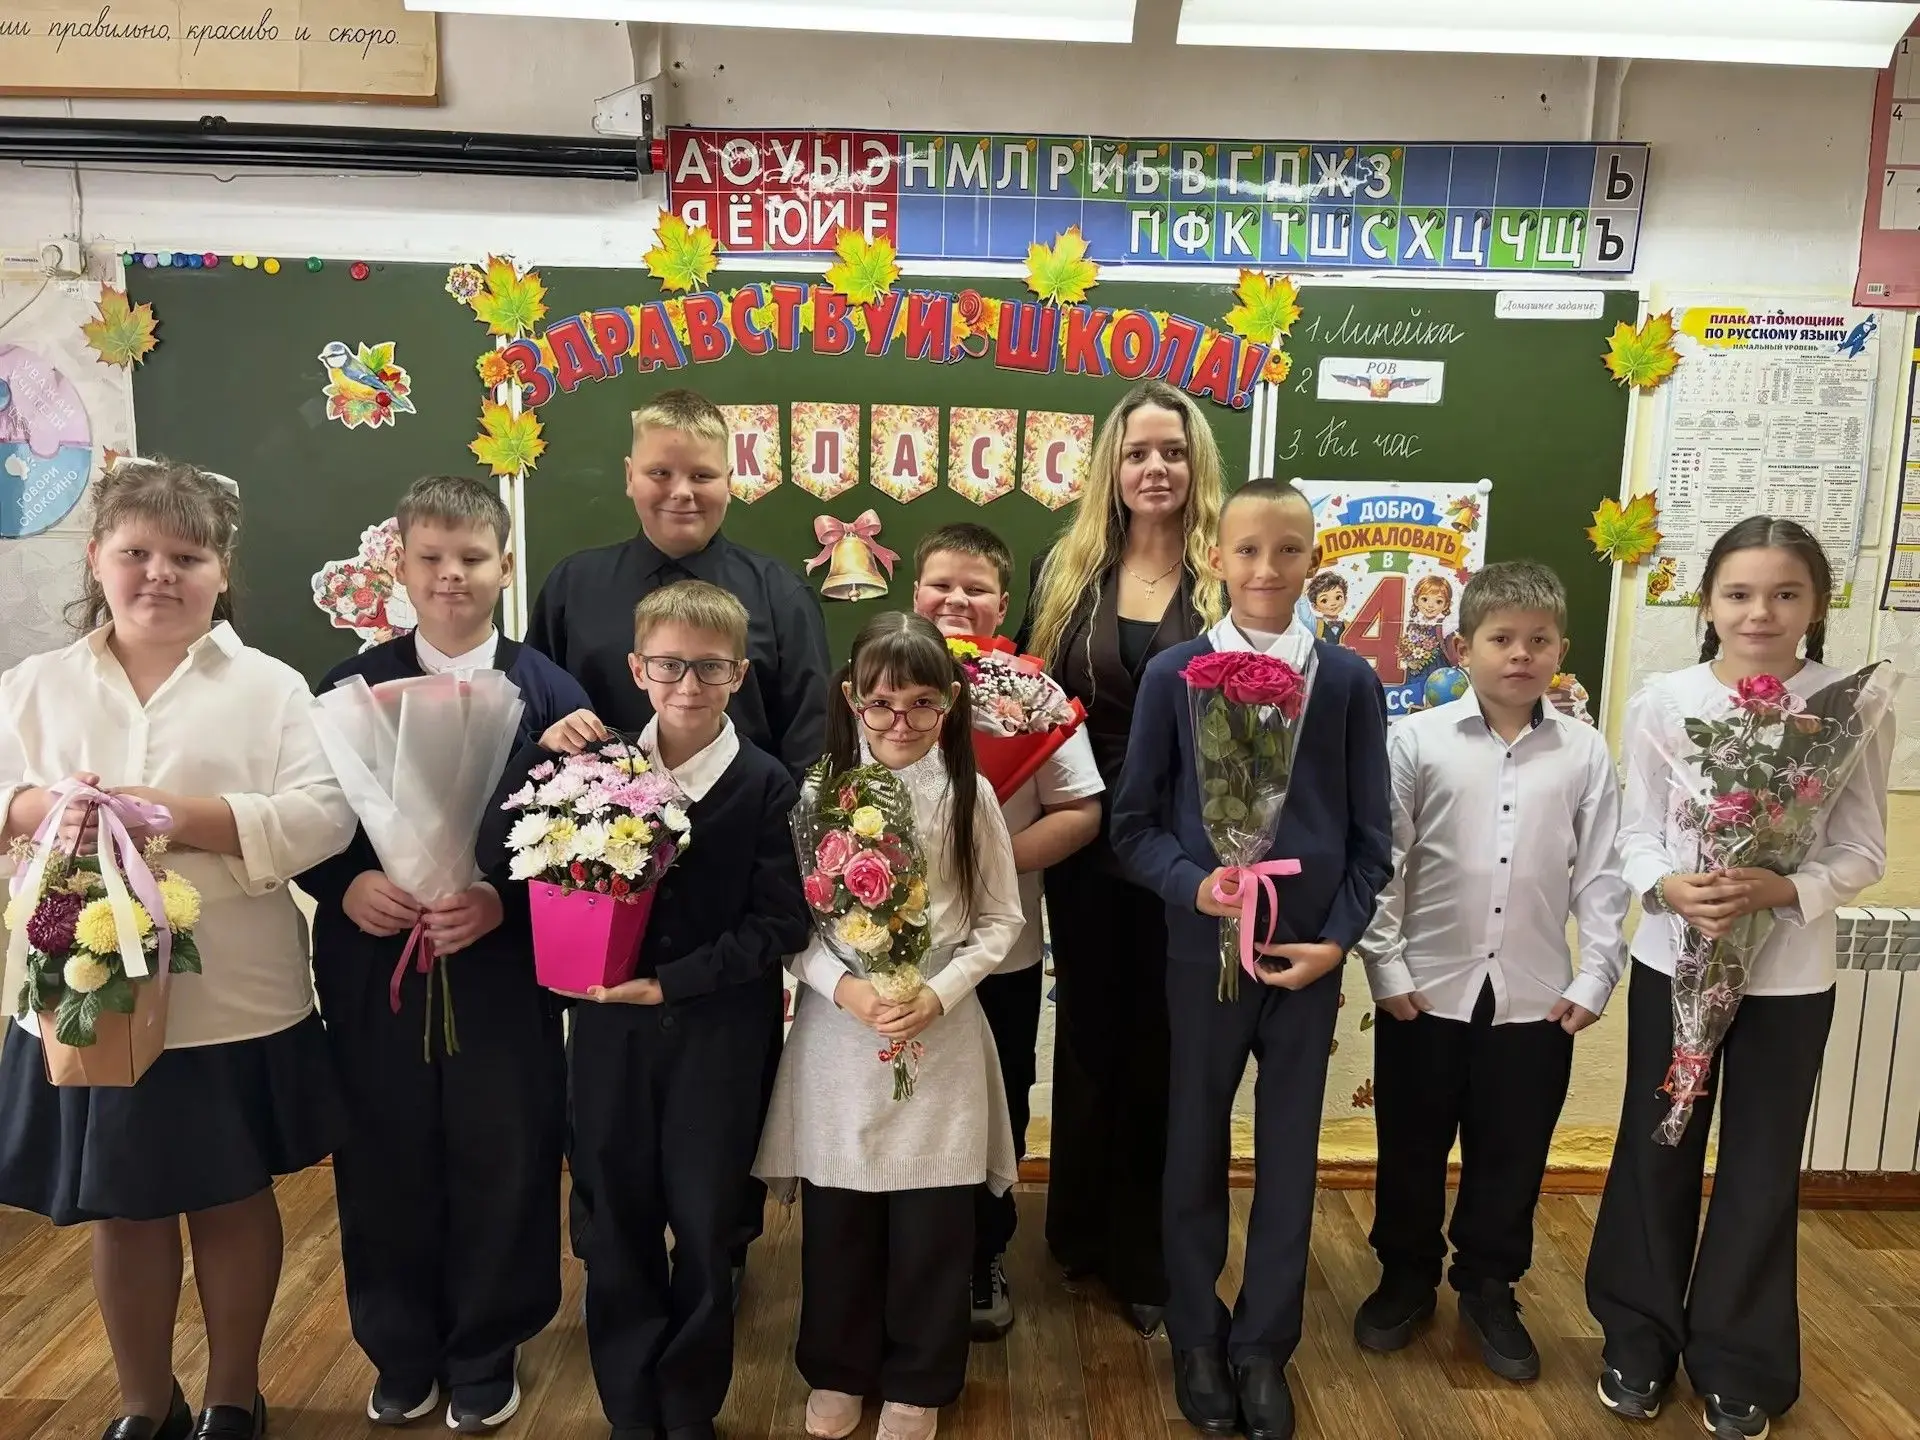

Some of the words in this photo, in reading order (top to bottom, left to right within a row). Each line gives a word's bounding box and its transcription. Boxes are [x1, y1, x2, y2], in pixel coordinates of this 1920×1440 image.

[48, 5, 171, 53] правильно,
[186, 7, 279, 56] красиво
[295, 26, 311, 41] и
[329, 27, 400, 60] скоро.
[1901, 39, 1909, 54] 1
[1892, 104, 1903, 120] 4
[1886, 170, 1897, 187] 7
[1503, 300, 1553, 311] Домашнее
[1710, 314, 1844, 326] ПЛАКАТ-ПОМОЩНИК
[1705, 329, 1723, 339] ПО
[1727, 329, 1798, 341] РУССКОМУ
[1800, 330, 1847, 342] ЯЗЫКУ
[993, 299, 1270, 409] ШКОЛА!
[1733, 343, 1783, 351] НАЧАЛЬНЫЙ
[1366, 361, 1398, 375] РОВ
[16, 466, 60, 509] ГОВОРИ
[1360, 500, 1425, 522] ДОБРО
[1325, 526, 1456, 555] ПОЖАЛОВАТЬ
[1382, 551, 1394, 568] В
[1341, 576, 1406, 685] 4
